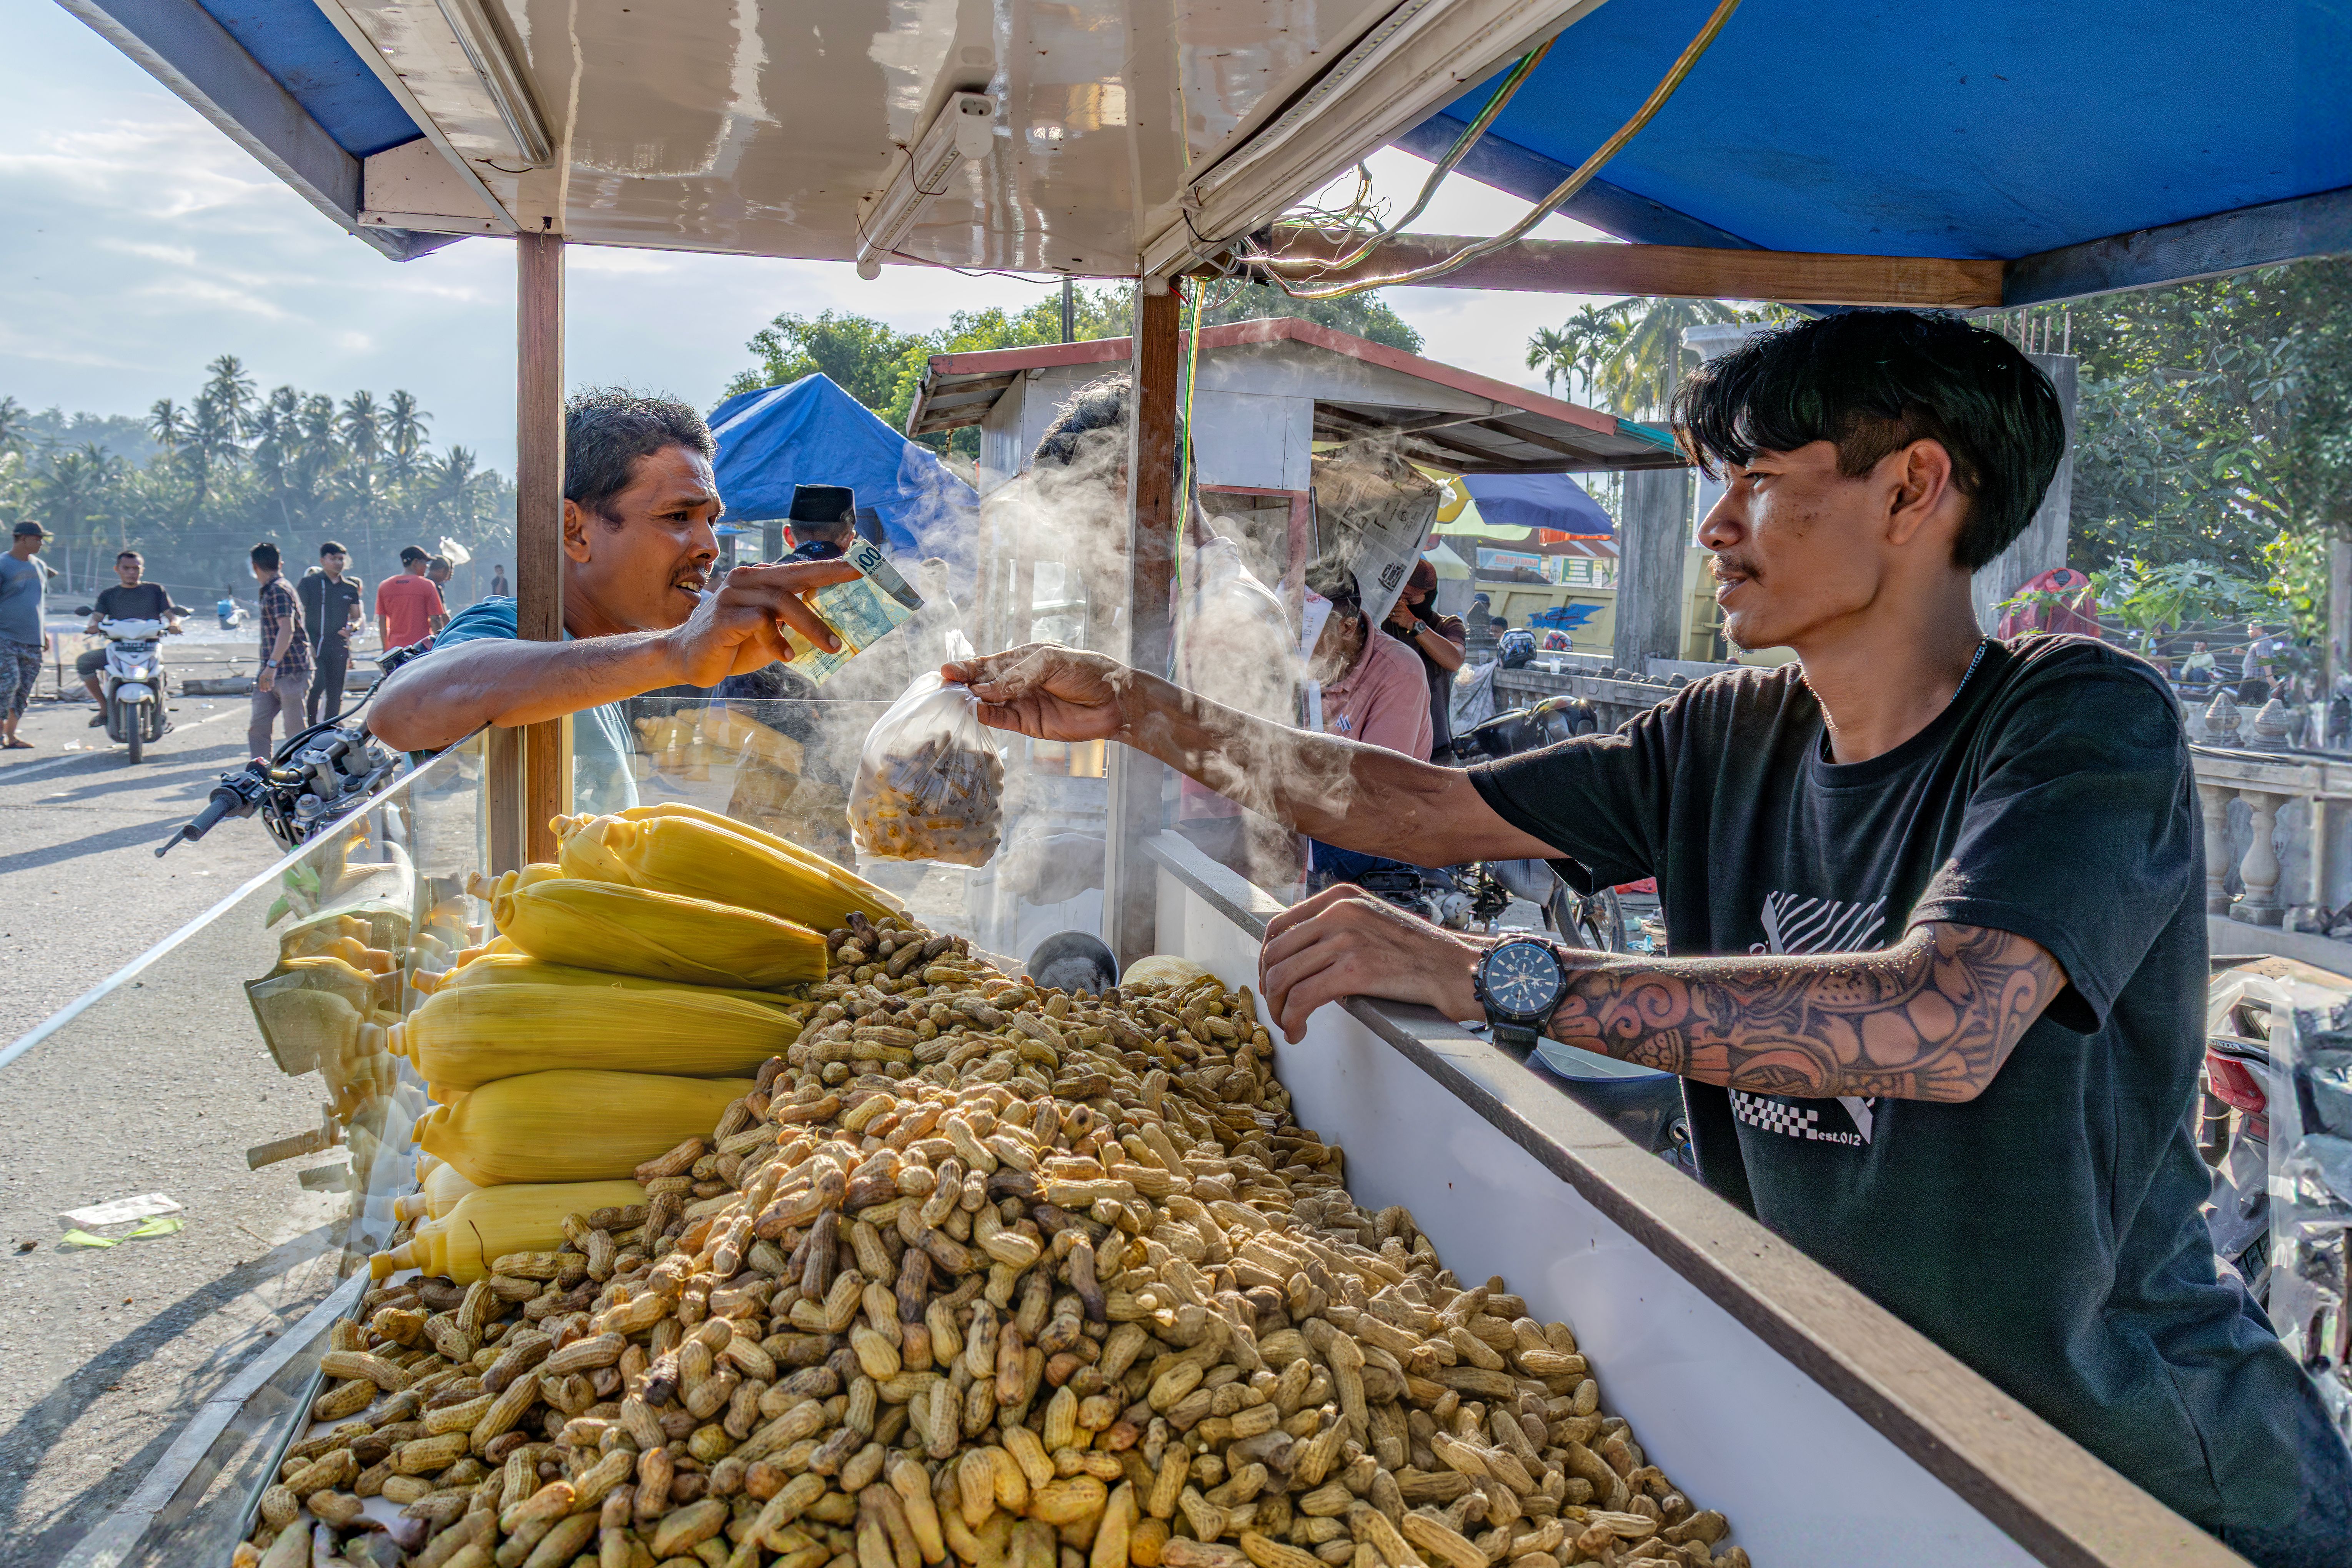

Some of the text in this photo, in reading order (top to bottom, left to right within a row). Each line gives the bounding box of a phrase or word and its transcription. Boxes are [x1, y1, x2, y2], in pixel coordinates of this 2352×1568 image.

[872, 561, 883, 571] PULUH
[817, 665, 831, 677] PULUH
[829, 656, 838, 666] RIBU
